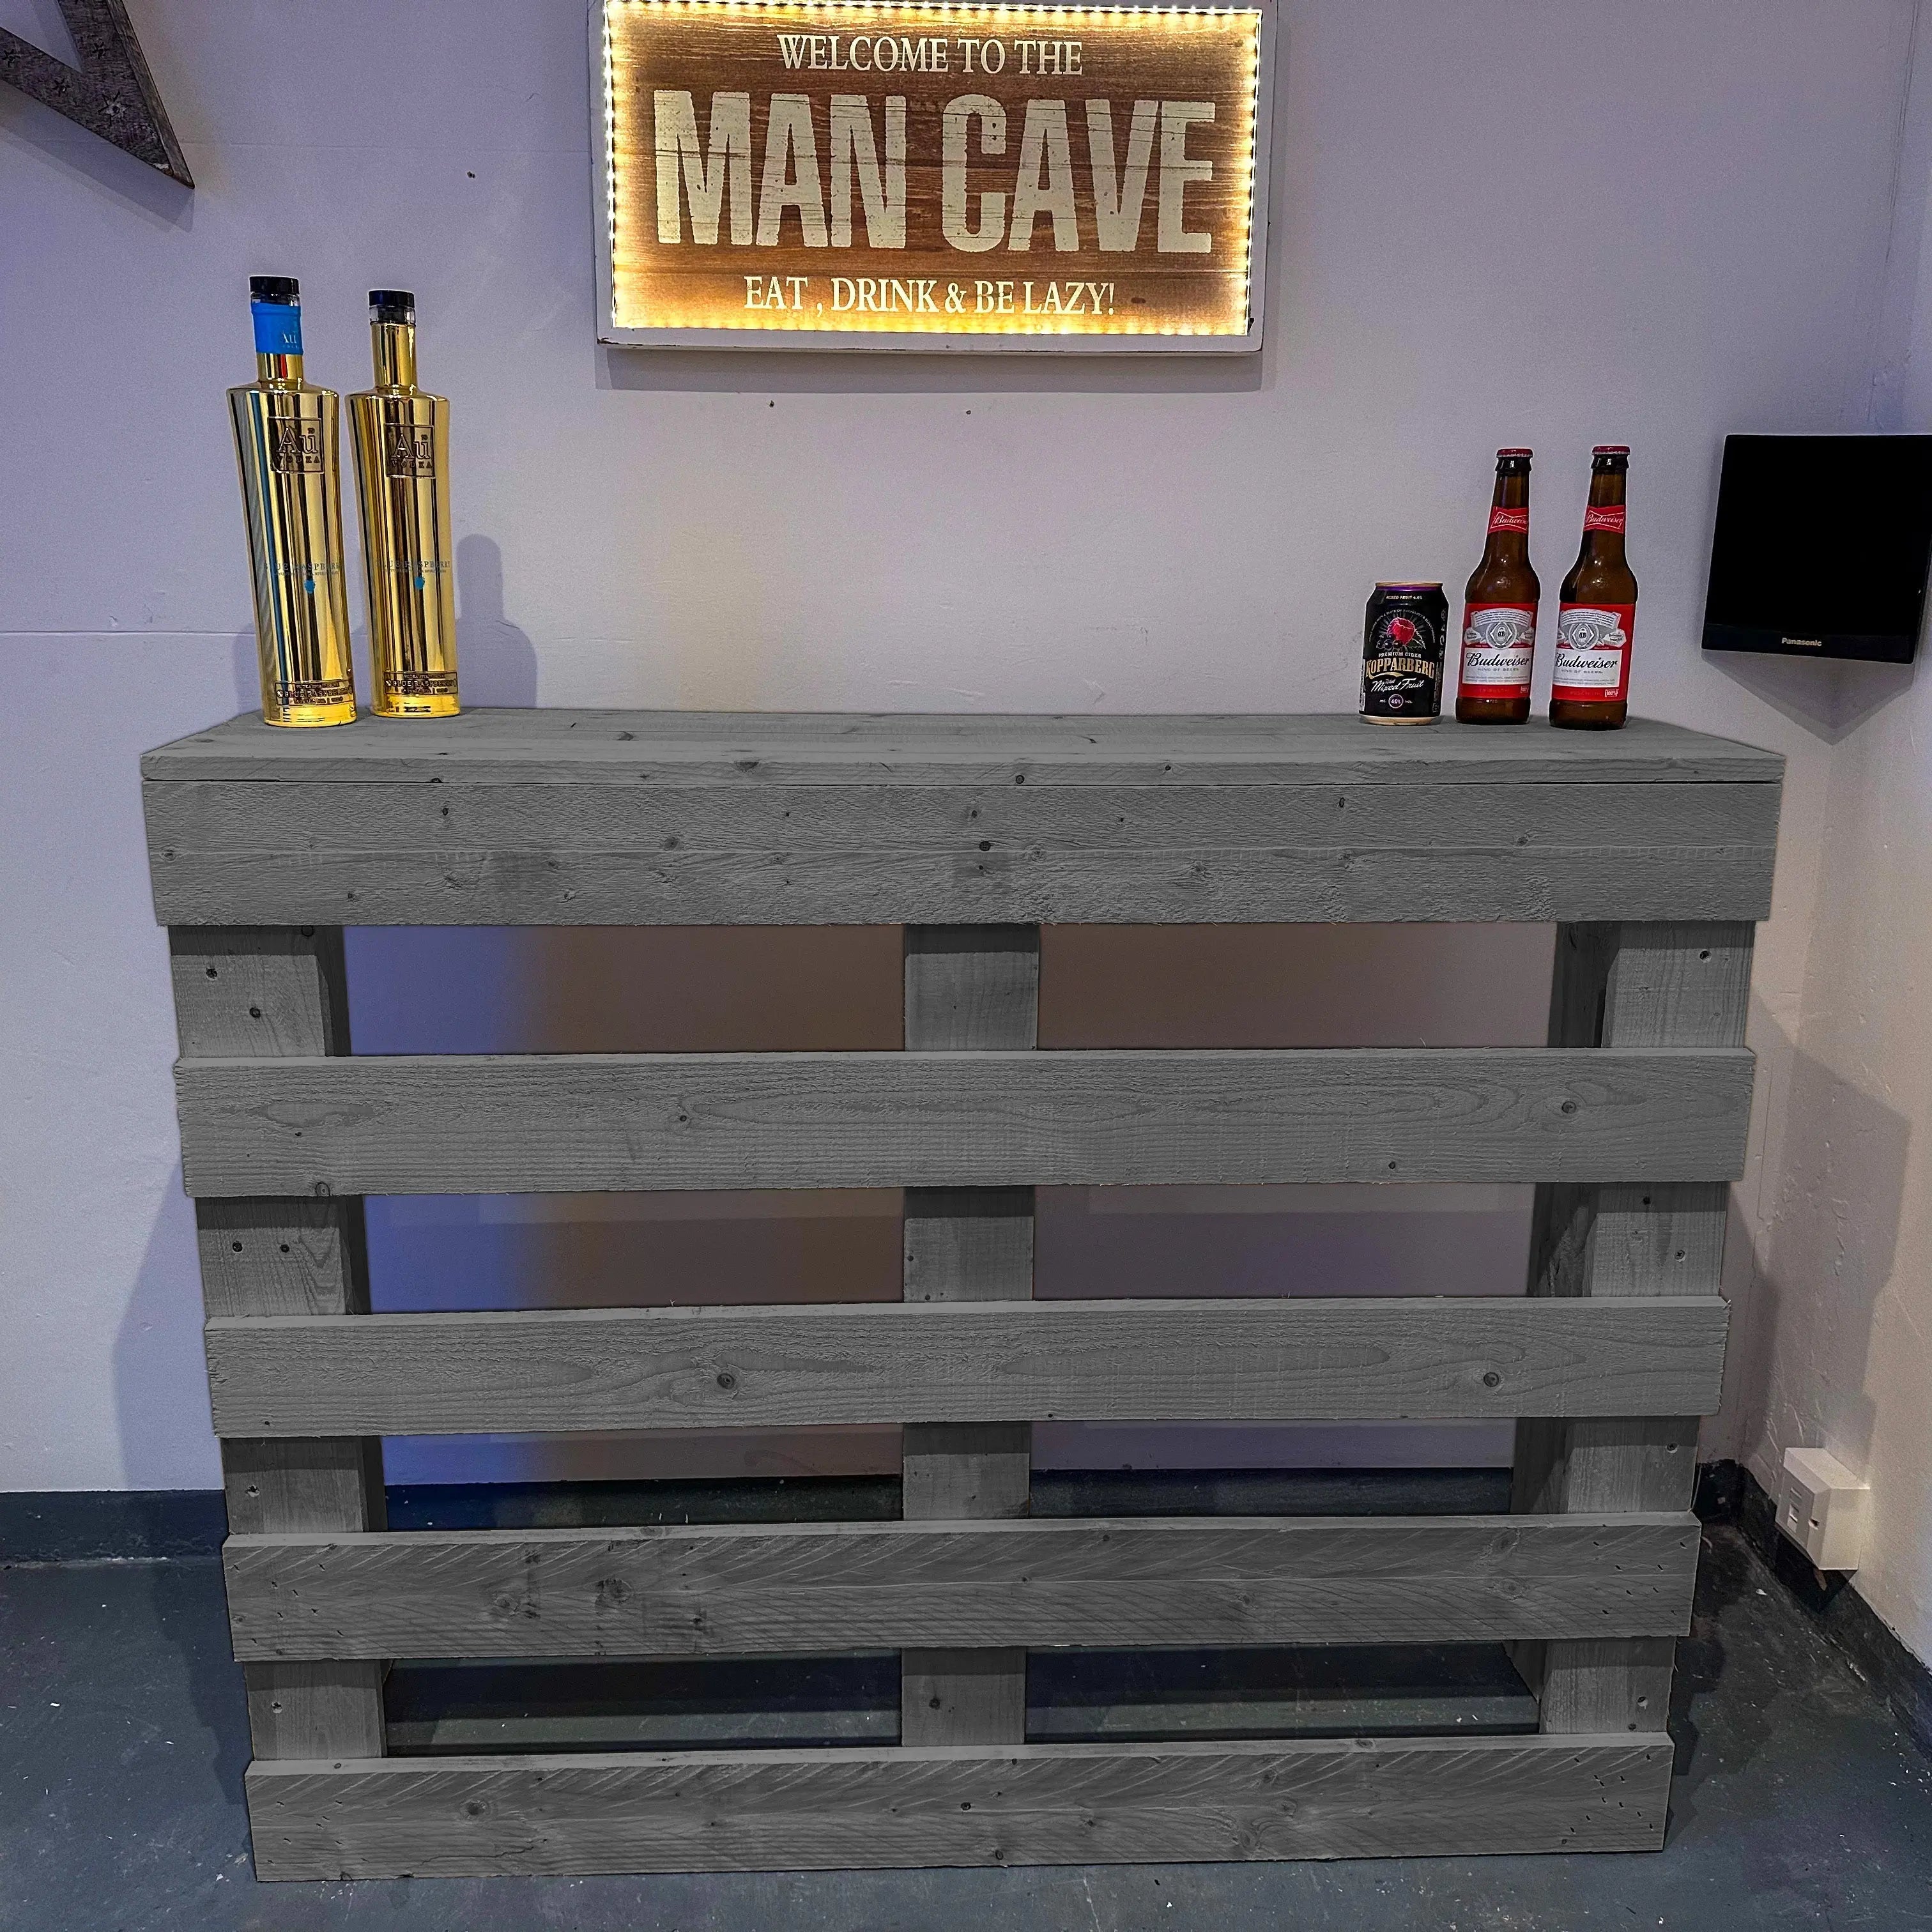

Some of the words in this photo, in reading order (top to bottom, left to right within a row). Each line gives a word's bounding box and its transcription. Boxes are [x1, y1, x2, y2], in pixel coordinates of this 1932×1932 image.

[777, 34, 948, 72] WELCOME
[957, 38, 1006, 75] TO
[1014, 40, 1083, 76] THE
[654, 89, 907, 249] MAN
[941, 93, 1216, 254] CAVE
[831, 277, 939, 314] DRINK
[944, 282, 967, 314] &
[974, 280, 1015, 315] BE
[1023, 281, 1116, 316] LAZY!
[277, 456, 320, 464] VODKA
[392, 460, 433, 469] VODKA
[1781, 637, 1822, 647] Panasonic
[1466, 652, 1530, 667] Budweiser
[1554, 652, 1618, 669] Budweiser
[1365, 657, 1435, 680] KOPPARBERG
[1370, 680, 1402, 693] Mixed
[1399, 677, 1425, 691] Fruit
